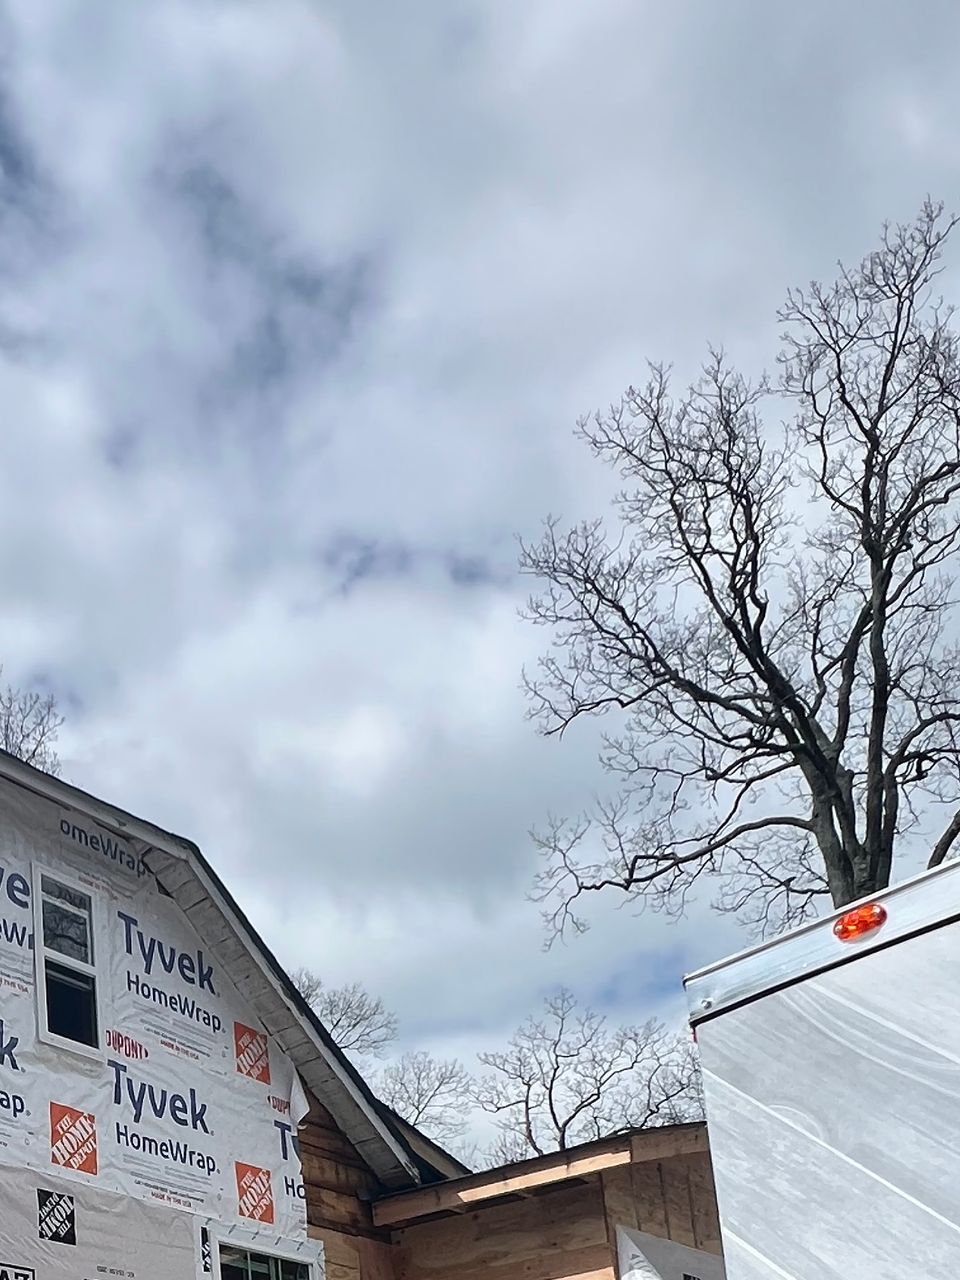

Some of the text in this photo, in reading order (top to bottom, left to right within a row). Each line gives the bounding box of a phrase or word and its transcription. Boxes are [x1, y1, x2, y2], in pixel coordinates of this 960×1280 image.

[60, 819, 146, 878] omeWrap
[117, 911, 216, 995] Tyvek
[126, 970, 221, 1033] HomeWrap
[107, 1059, 210, 1135] Tyvek
[51, 1113, 96, 1165] HOME
[69, 1137, 97, 1168] DEPOT
[116, 1122, 216, 1177] HomeWrap
[39, 1195, 75, 1240] HOME
[239, 1169, 271, 1216] HOME
